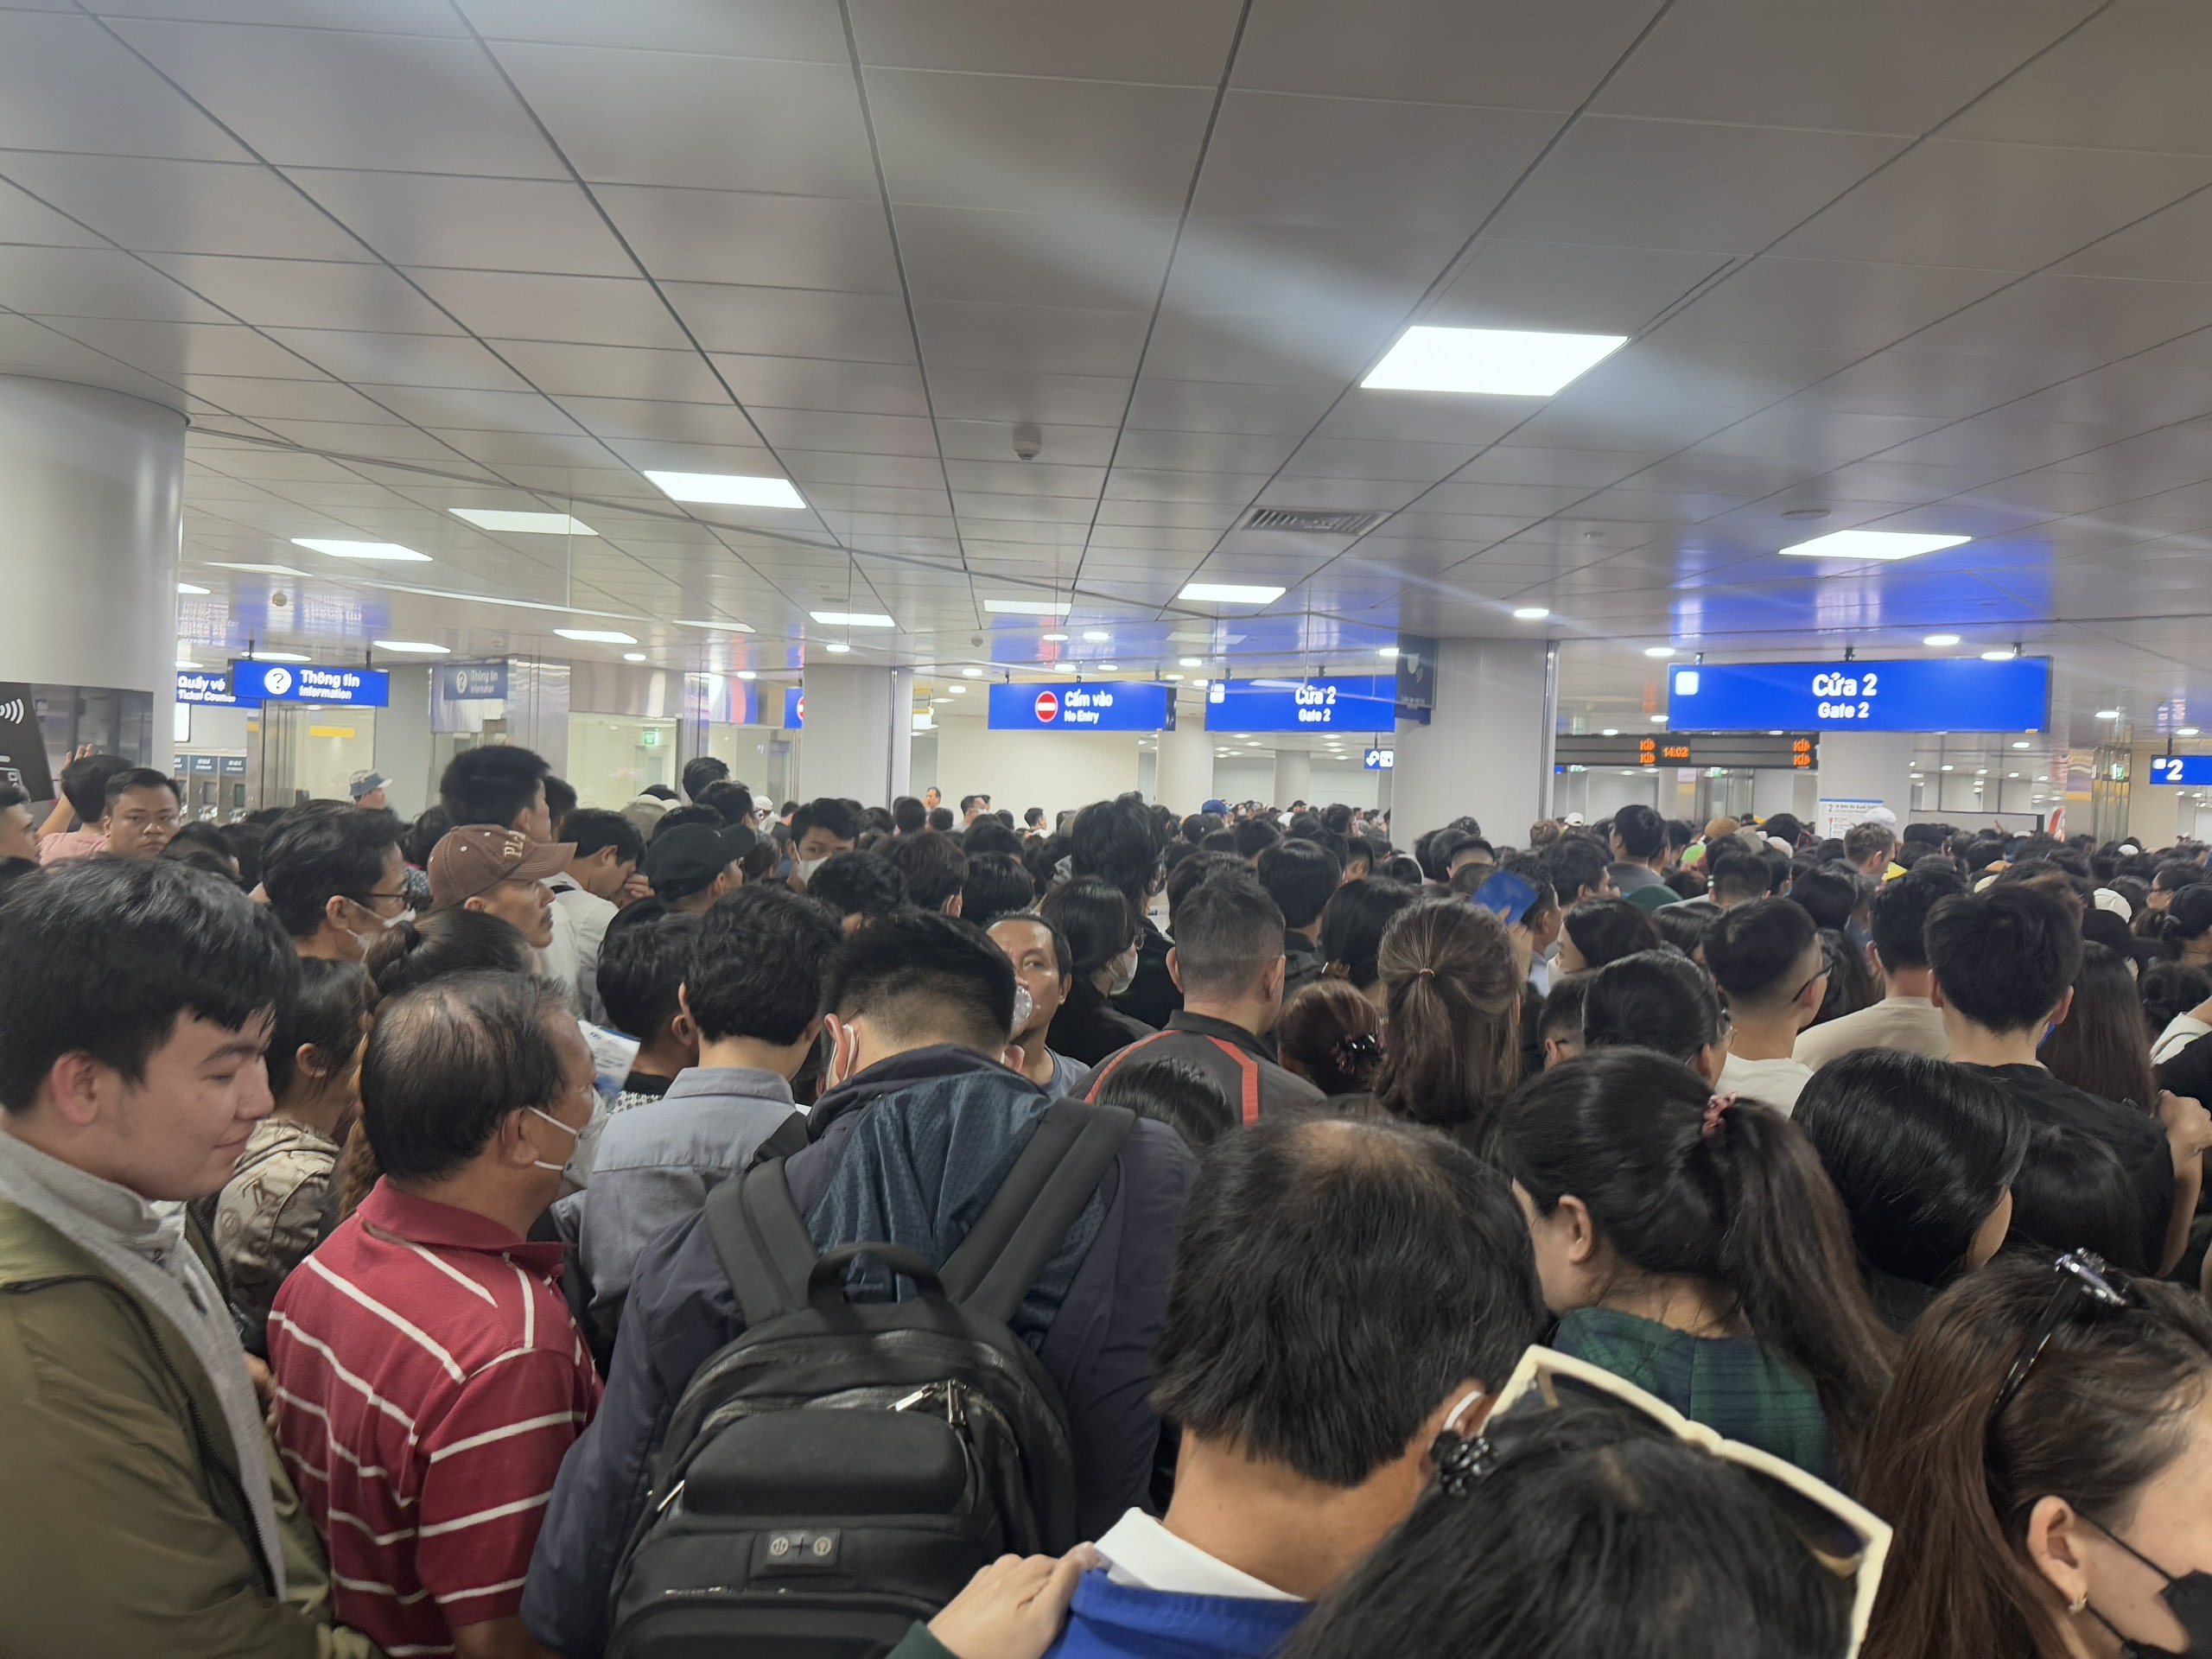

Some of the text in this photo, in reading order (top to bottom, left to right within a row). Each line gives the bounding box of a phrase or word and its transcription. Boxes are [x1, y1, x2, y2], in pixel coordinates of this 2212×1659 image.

[300, 670, 360, 688] Thông tin
[1813, 671, 1878, 696] Cửa 2
[299, 685, 353, 699] Information
[1065, 689, 1113, 707] Cấm vào
[1325, 686, 1337, 704] 2
[1064, 709, 1100, 724] No Entry
[1299, 709, 1332, 721] Gate 2
[1818, 702, 1870, 718] Gate 2
[1663, 747, 1688, 757] 14:02
[2166, 759, 2183, 780] 2
